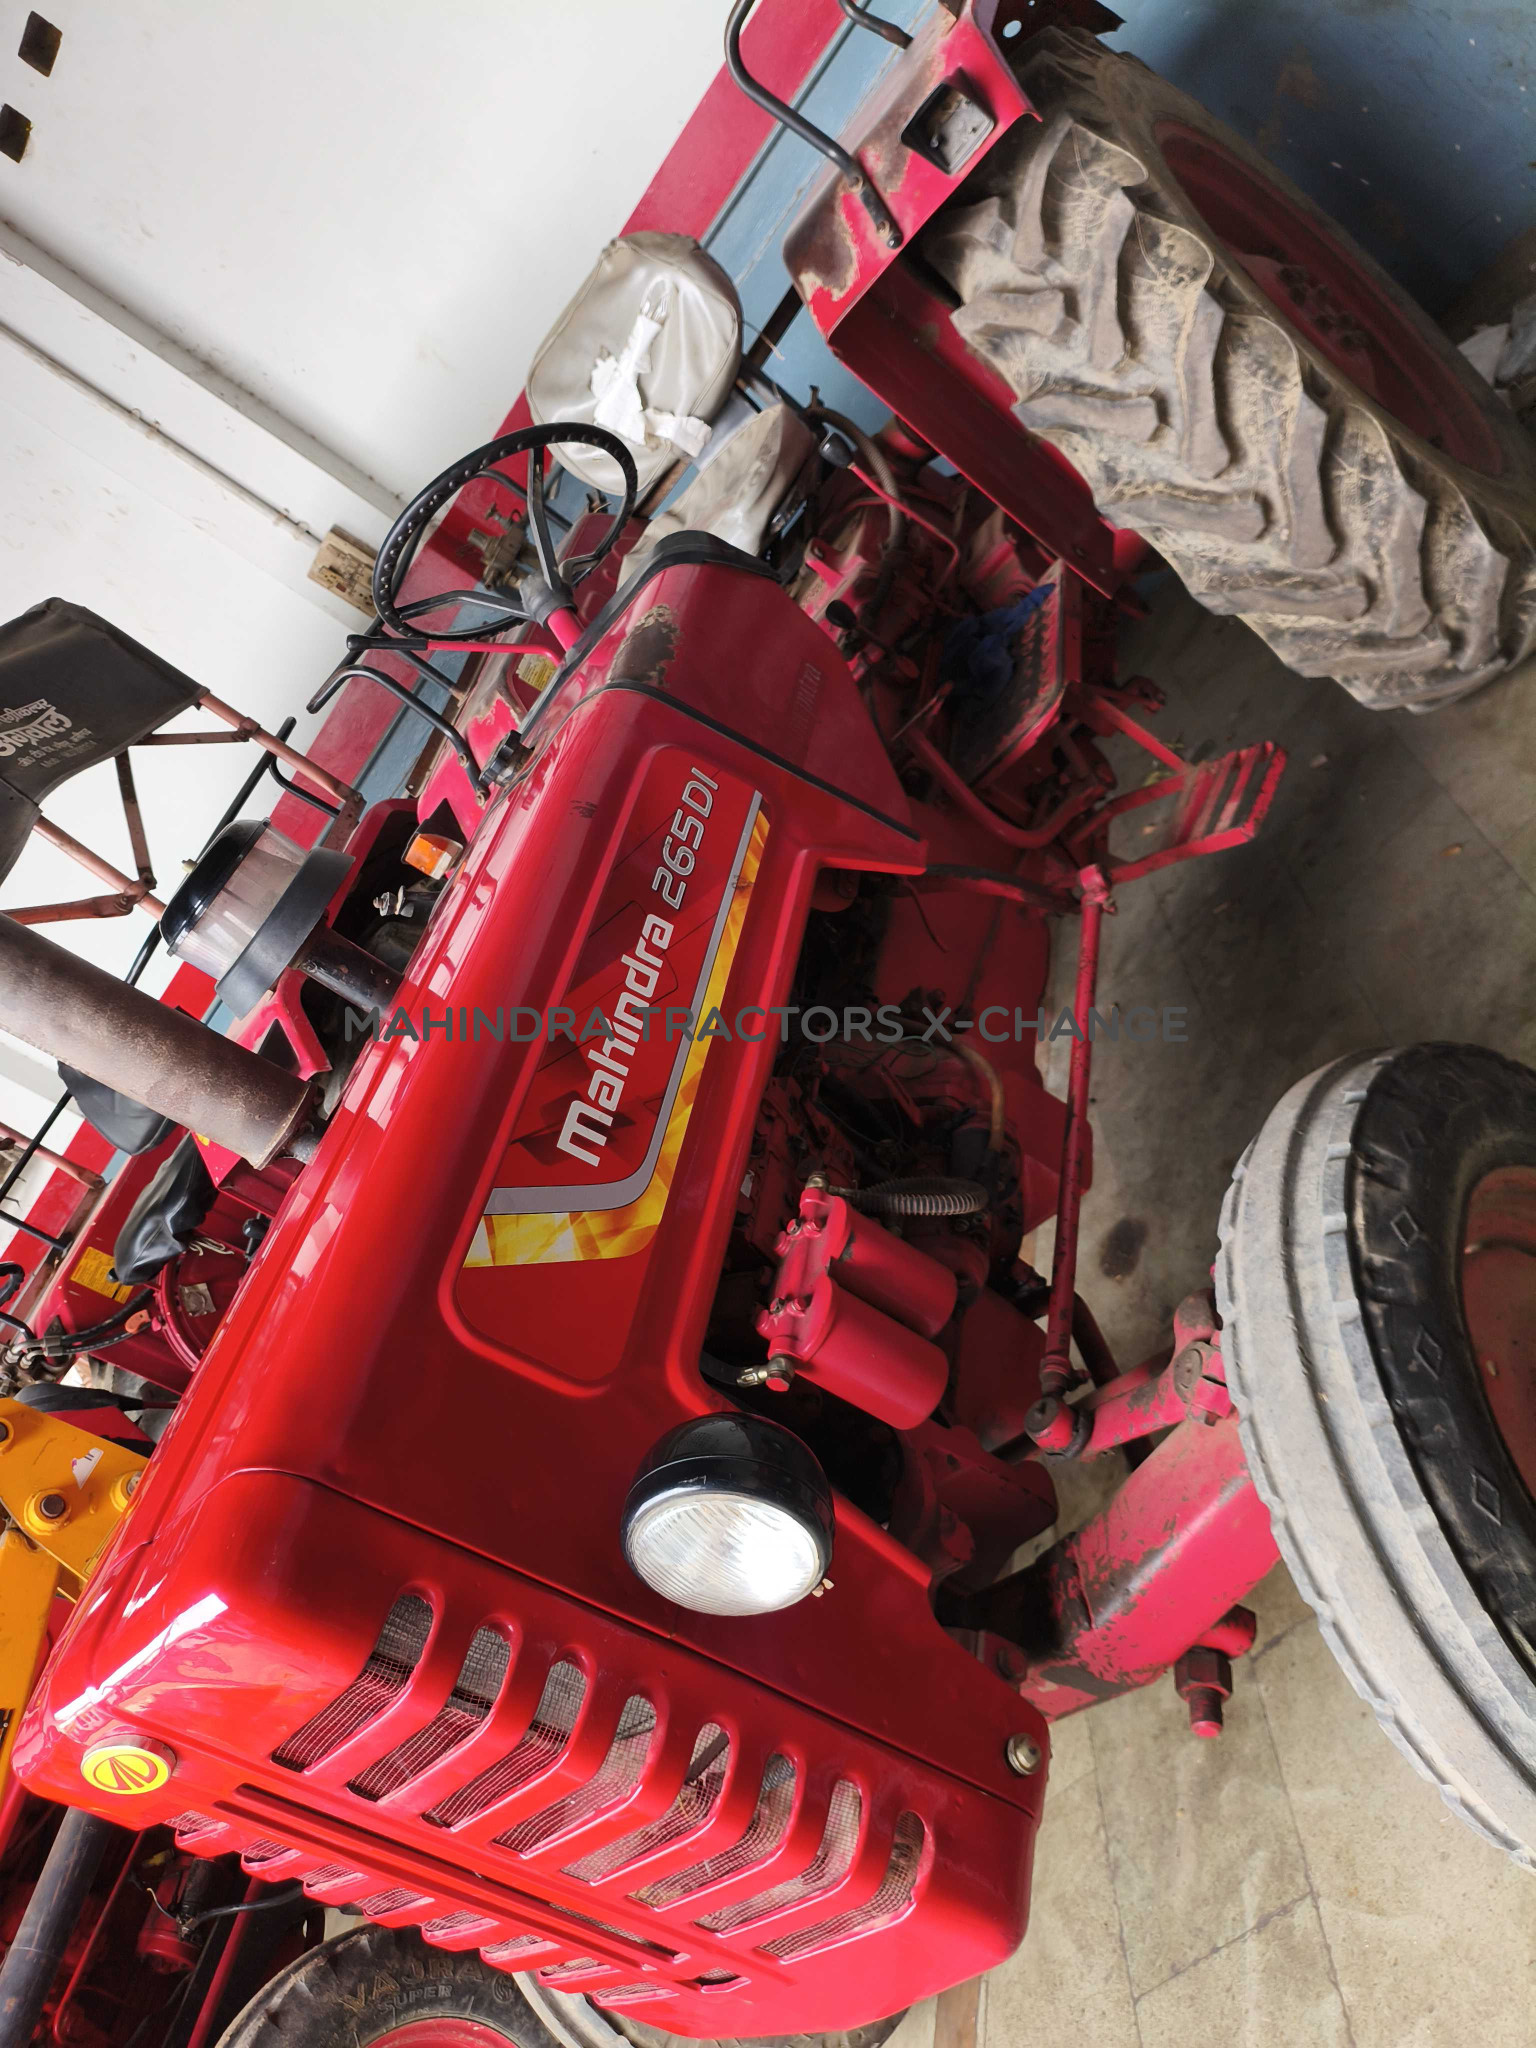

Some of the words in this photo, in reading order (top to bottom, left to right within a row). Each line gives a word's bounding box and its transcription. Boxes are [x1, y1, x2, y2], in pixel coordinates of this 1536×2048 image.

[651, 766, 719, 910] 265DI
[337, 1957, 485, 2014] VAJRA
[376, 1984, 453, 2015] SUPER
